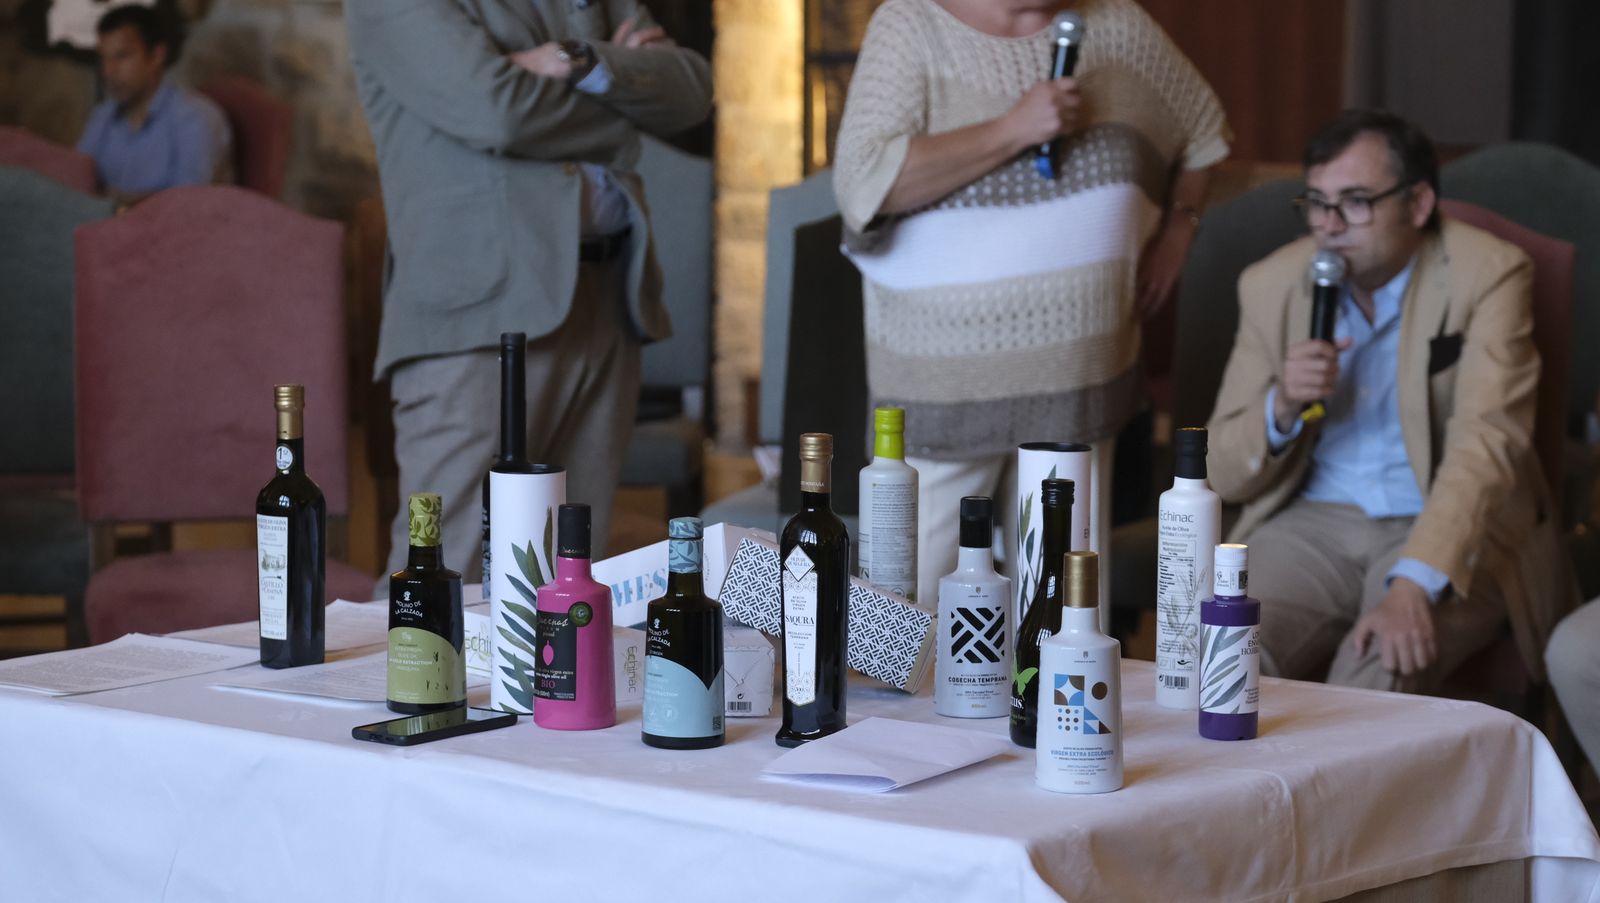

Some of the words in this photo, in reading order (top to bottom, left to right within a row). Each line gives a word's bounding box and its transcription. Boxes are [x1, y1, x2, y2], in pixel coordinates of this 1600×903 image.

[1160, 509, 1194, 523] Echinac
[396, 600, 414, 608] MOLINO
[400, 608, 423, 618] CALZADA
[786, 615, 815, 626] SAQURA
[650, 636, 671, 647] CALZADA
[541, 680, 556, 689] BIO
[978, 676, 1008, 684] TEMPRANA
